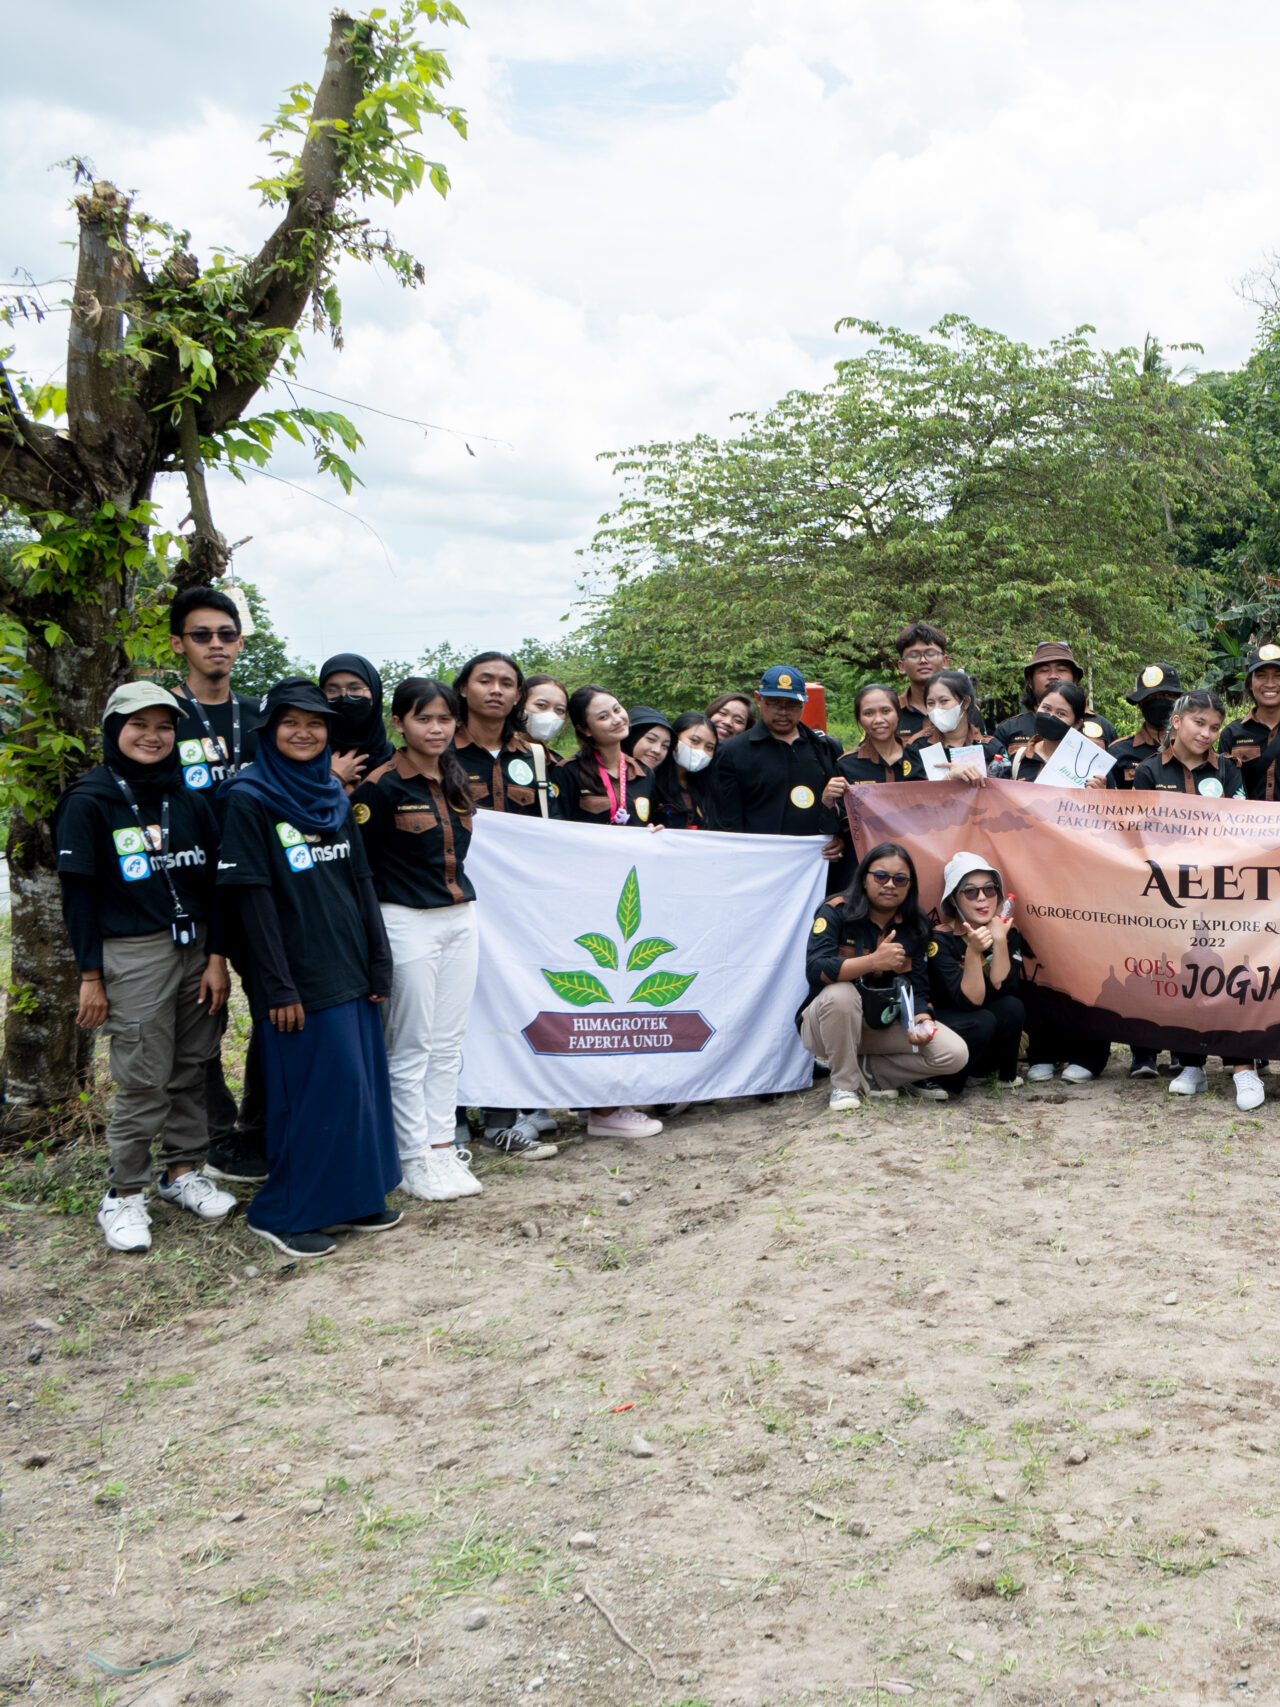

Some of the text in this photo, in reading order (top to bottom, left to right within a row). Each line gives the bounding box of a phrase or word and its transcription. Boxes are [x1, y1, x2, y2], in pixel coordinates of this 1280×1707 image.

[1057, 800, 1135, 816] HIMPUNAN
[1137, 804, 1221, 822] MAHASISWA
[1056, 815, 1126, 832] FAKULTAS
[1127, 820, 1209, 836] PERTANIAN
[150, 845, 207, 871] msmb
[1138, 859, 1280, 909] AEET
[1026, 903, 1188, 930] (AGROECOTECHNOLOGY
[1191, 919, 1261, 932] EXPLORE
[1264, 920, 1280, 934] &
[1189, 936, 1226, 948] 2022
[1123, 956, 1176, 979] GOES
[1150, 979, 1179, 998] TO
[572, 1016, 668, 1032] HIMAGROTEK
[568, 1033, 674, 1050] FAPERTA UNUD
